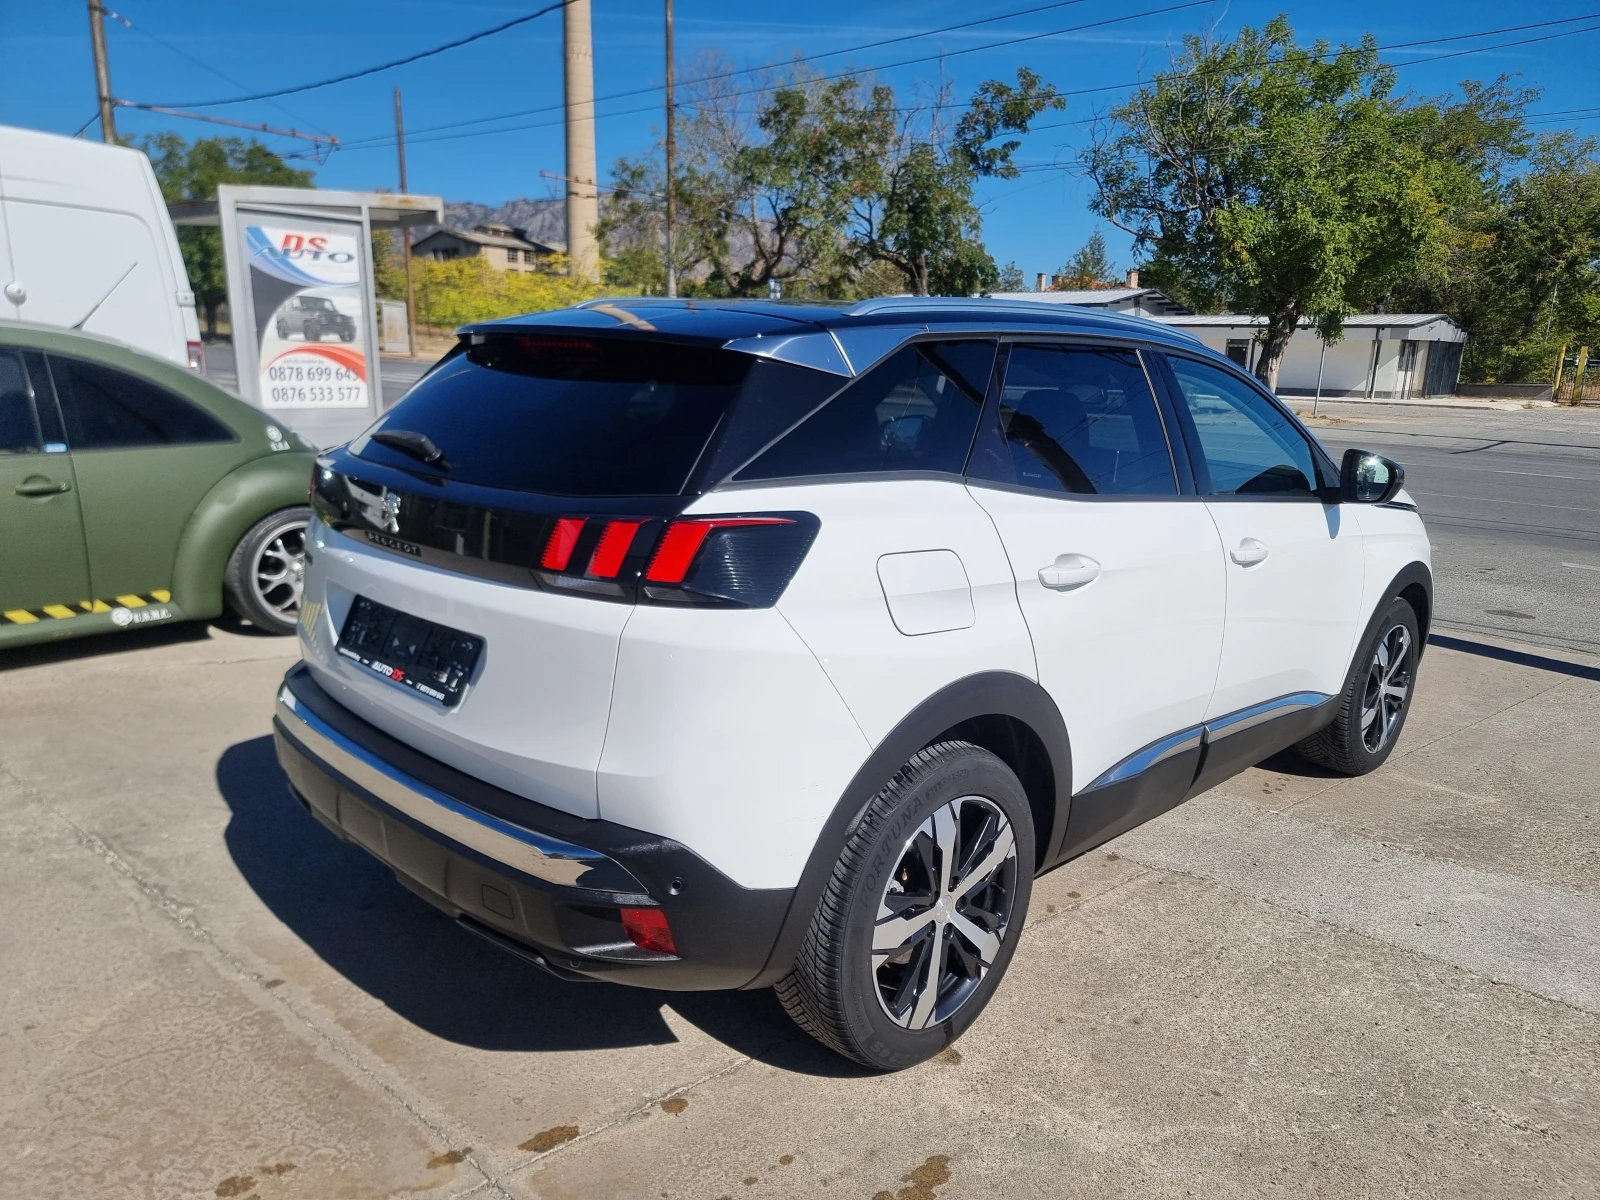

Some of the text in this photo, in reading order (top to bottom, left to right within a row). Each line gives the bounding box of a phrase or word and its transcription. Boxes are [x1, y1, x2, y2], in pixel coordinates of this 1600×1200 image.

[281, 233, 328, 253] DS
[253, 246, 354, 263] AUTO
[269, 366, 359, 382] 0878 699 645
[272, 386, 360, 402] 0876 533 577
[367, 531, 418, 554] PEUGEOT
